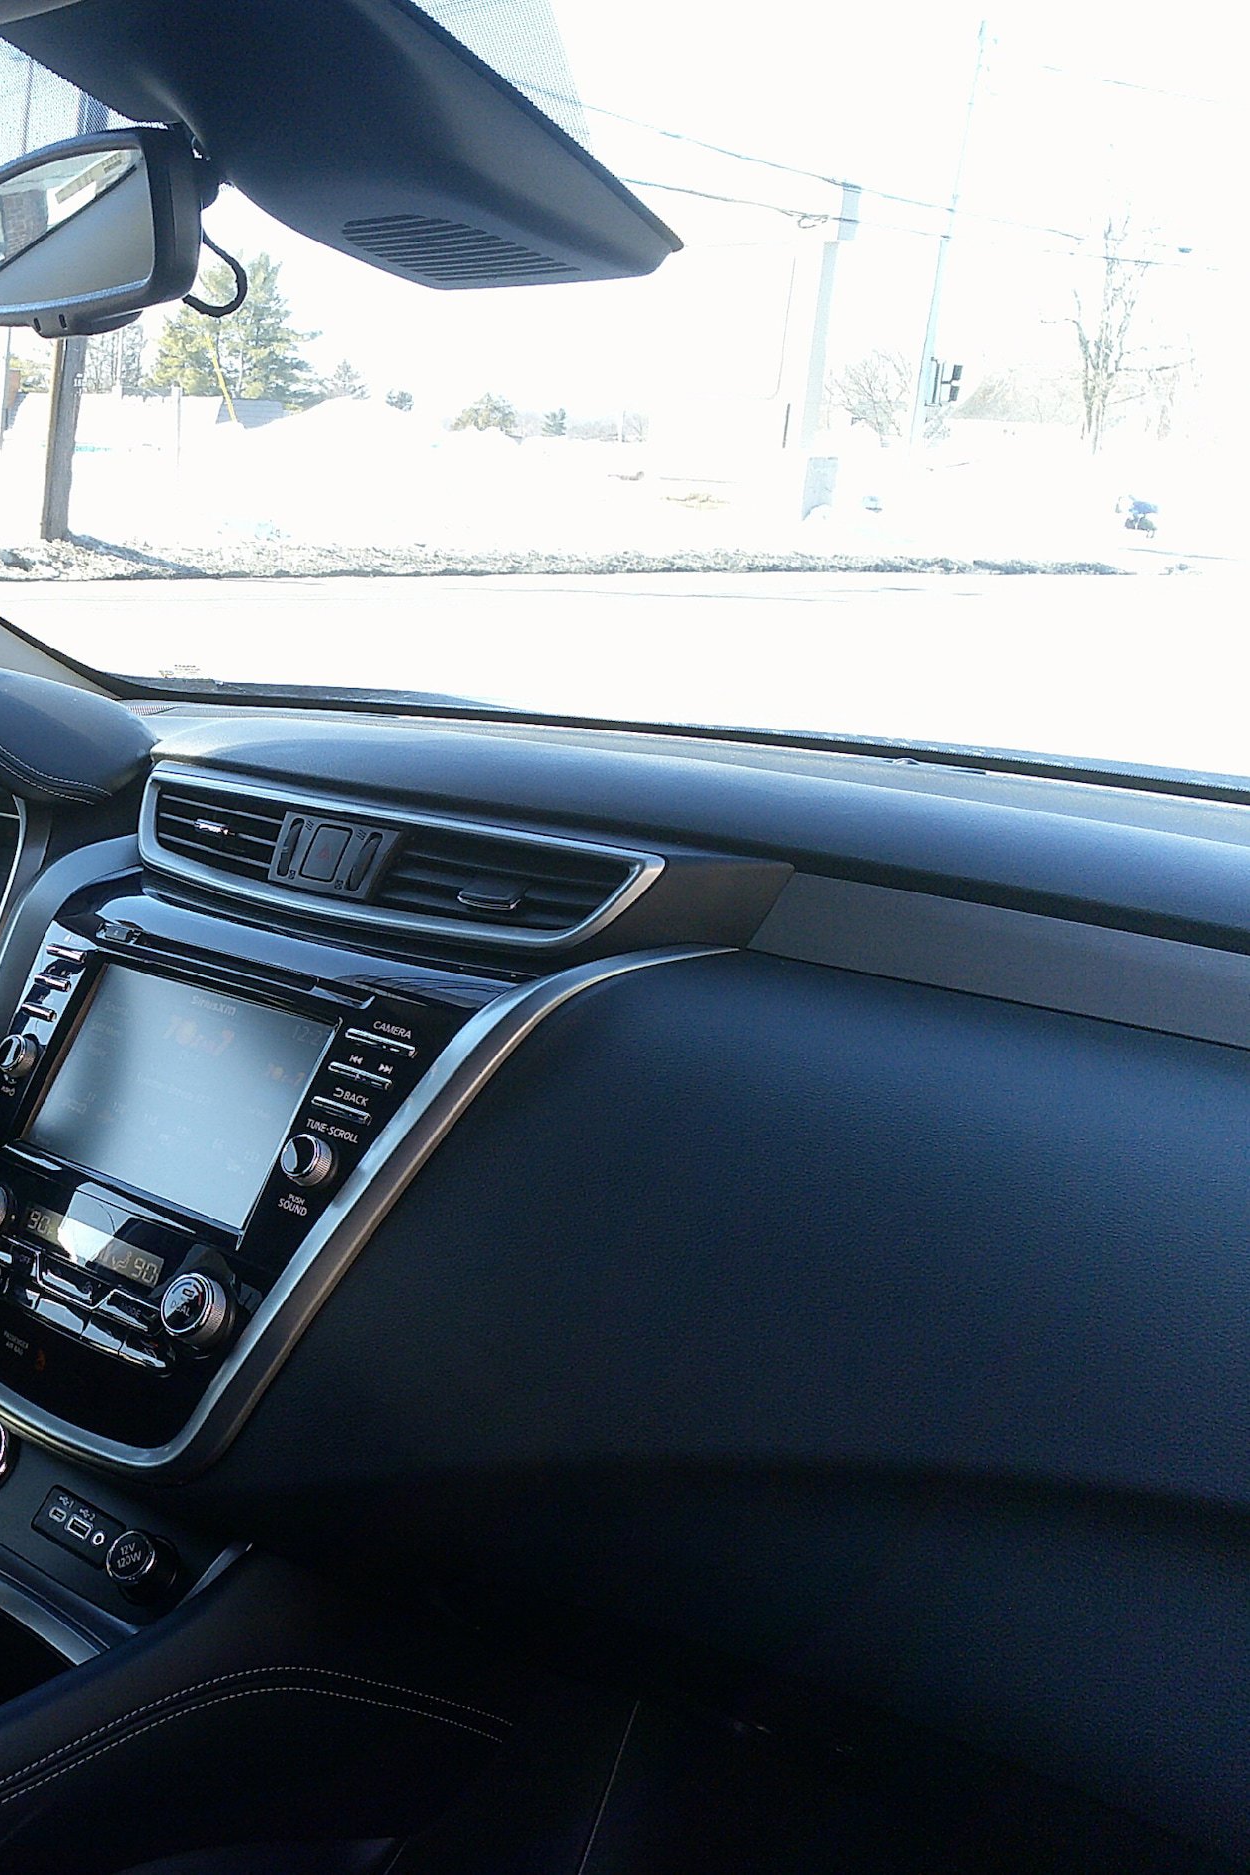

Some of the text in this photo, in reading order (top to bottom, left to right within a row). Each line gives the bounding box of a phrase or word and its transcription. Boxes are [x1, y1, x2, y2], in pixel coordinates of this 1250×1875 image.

[373, 1019, 413, 1040] CAMERA
[343, 1090, 370, 1107] BACK
[277, 1197, 308, 1218] SOUND
[120, 1542, 136, 1555] 12V
[116, 1551, 142, 1569] 120W
